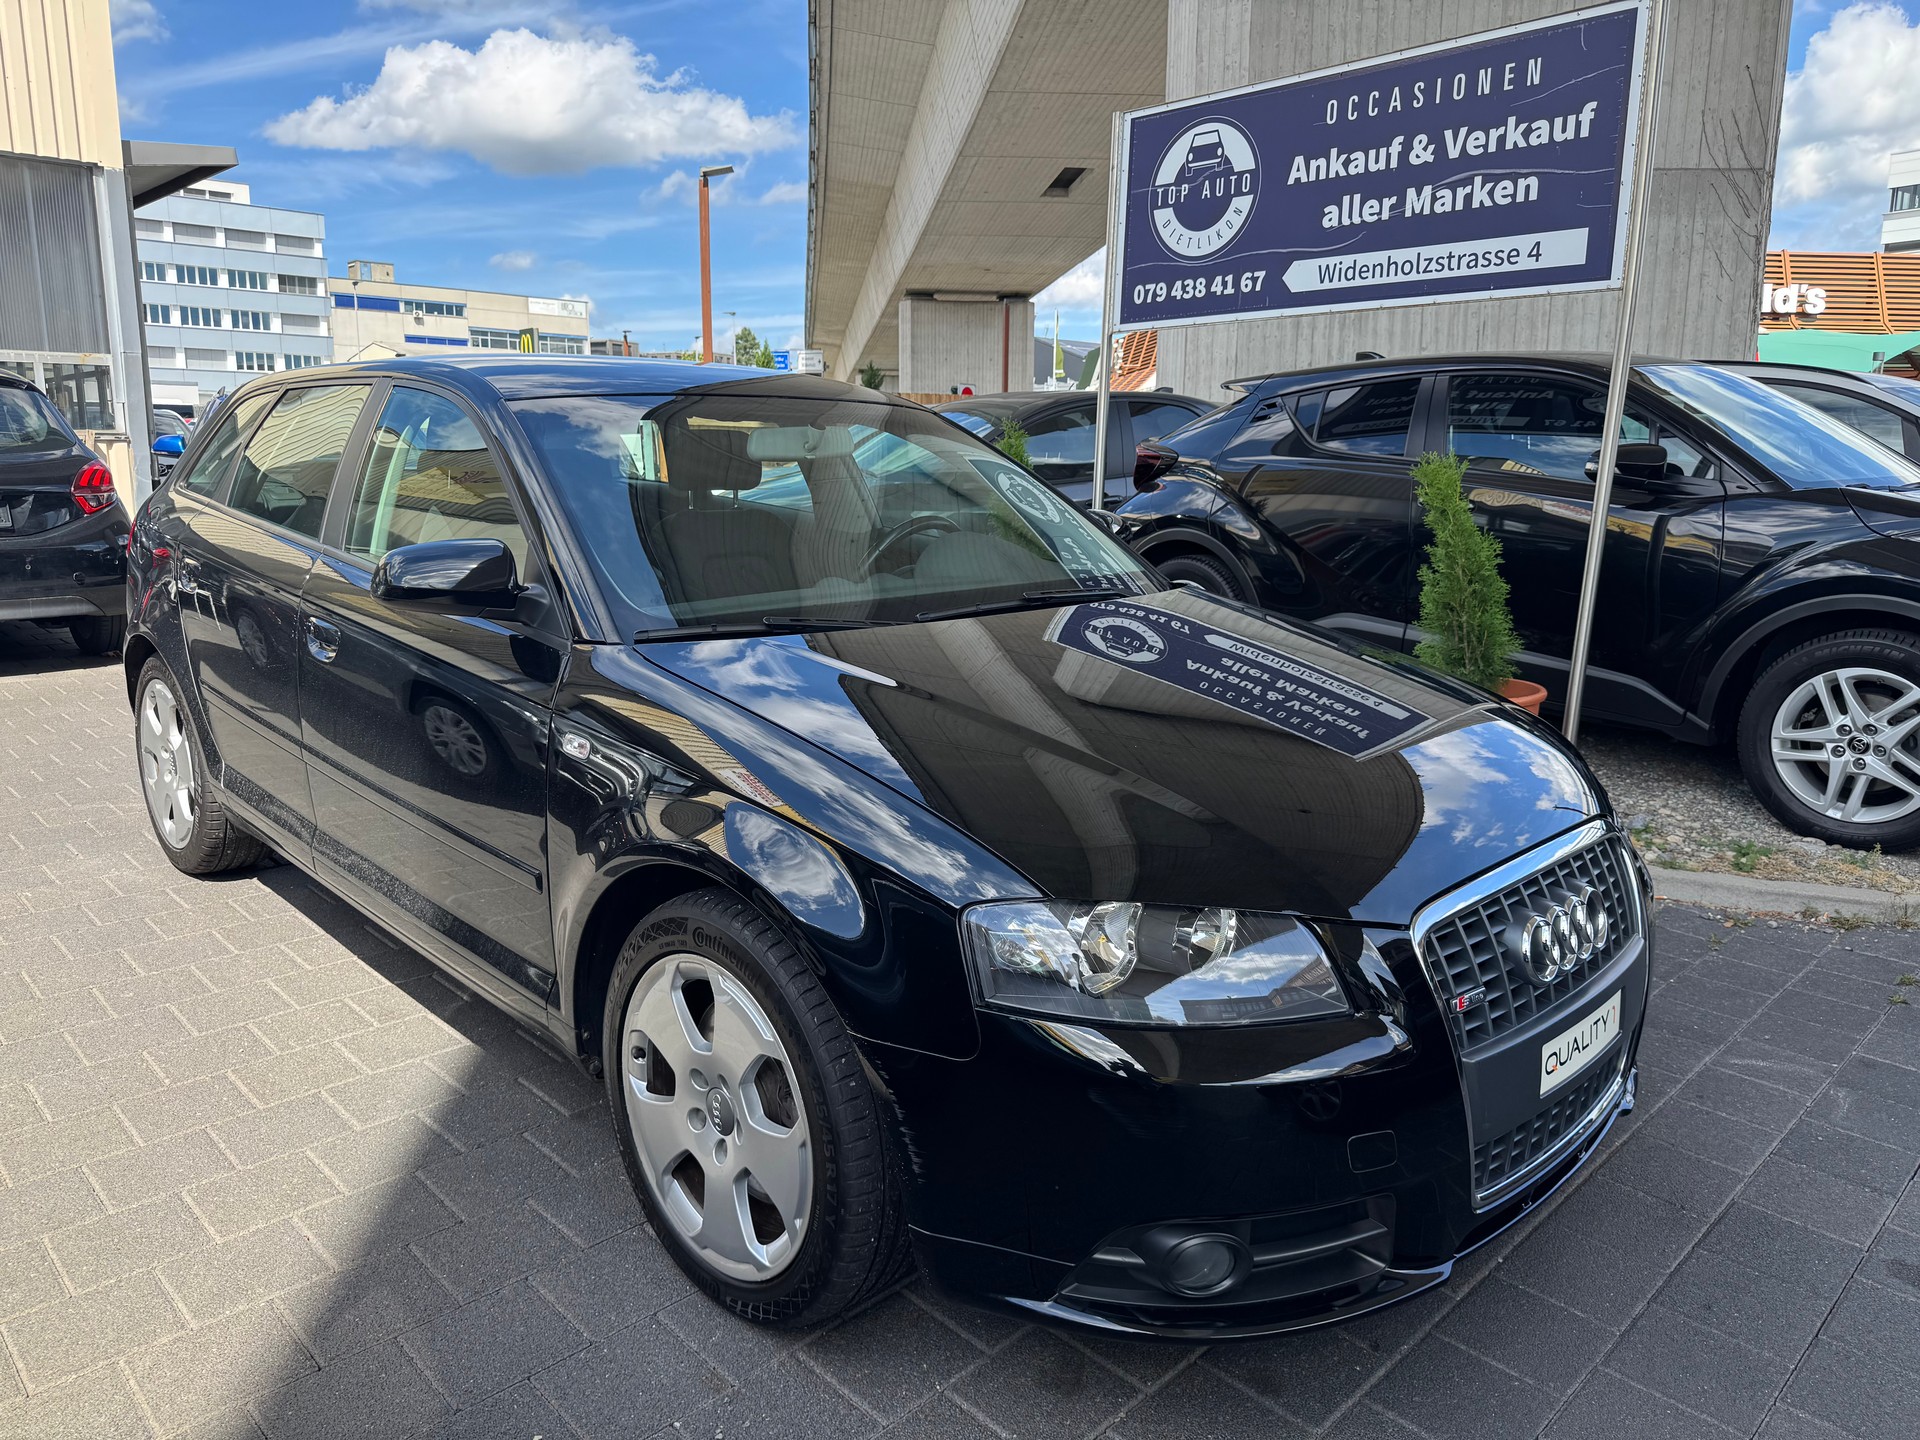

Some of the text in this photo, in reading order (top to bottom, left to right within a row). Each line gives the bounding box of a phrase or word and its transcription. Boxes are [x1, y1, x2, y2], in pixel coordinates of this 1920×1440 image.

[1326, 57, 1542, 124] OCCASIONEN
[1287, 101, 1598, 185] Ankauf & Verkauf
[1157, 173, 1250, 206] TOP AUTO
[1321, 175, 1539, 229] aller Marken
[1162, 207, 1243, 249] DIETLIKON
[1317, 240, 1543, 285] Widenholzstrasse 4
[1133, 270, 1266, 304] 079 438 41 67
[1814, 645, 1905, 660] MICHELIN
[692, 926, 758, 988] Continental
